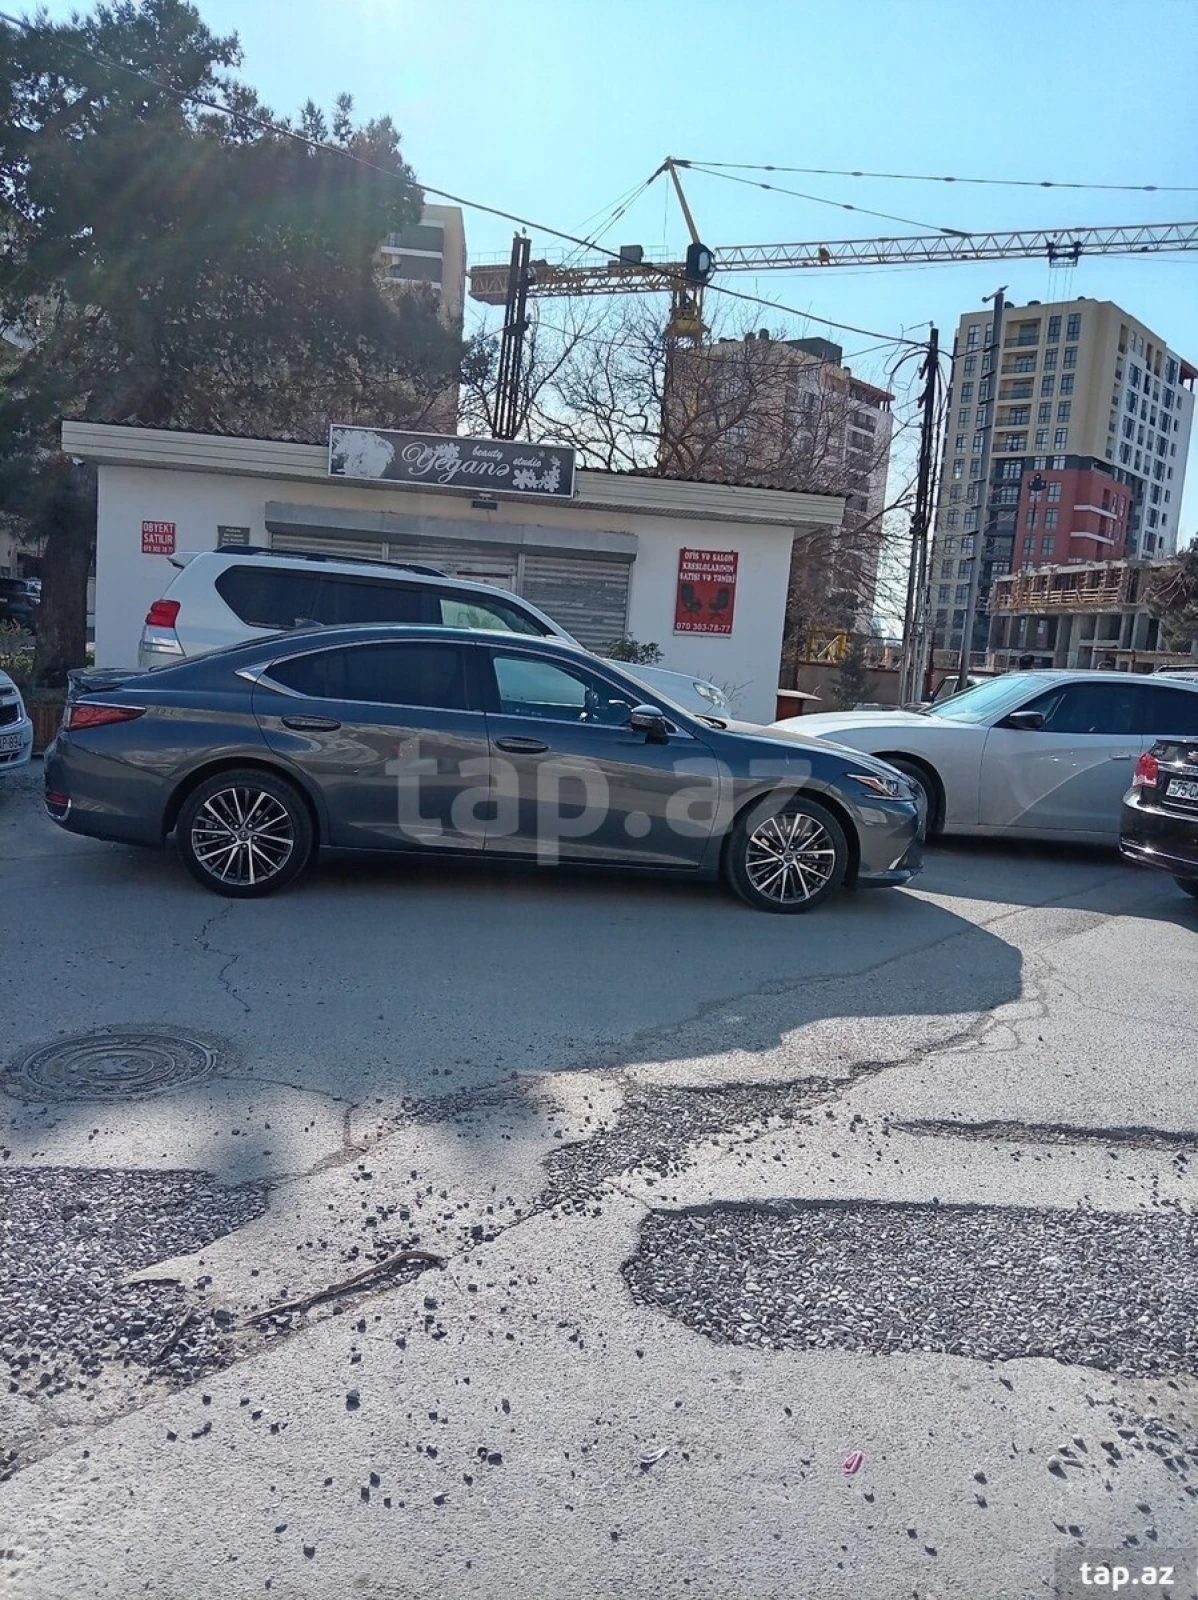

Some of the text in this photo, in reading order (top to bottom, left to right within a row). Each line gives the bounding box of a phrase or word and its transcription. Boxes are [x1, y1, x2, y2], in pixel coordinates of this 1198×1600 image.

[472, 445, 542, 468] beauty studio
[143, 522, 174, 533] OBYEKT
[143, 533, 174, 545] SATILIR
[701, 552, 711, 561] VƏ
[712, 553, 734, 563] SALON
[676, 622, 691, 630] 070
